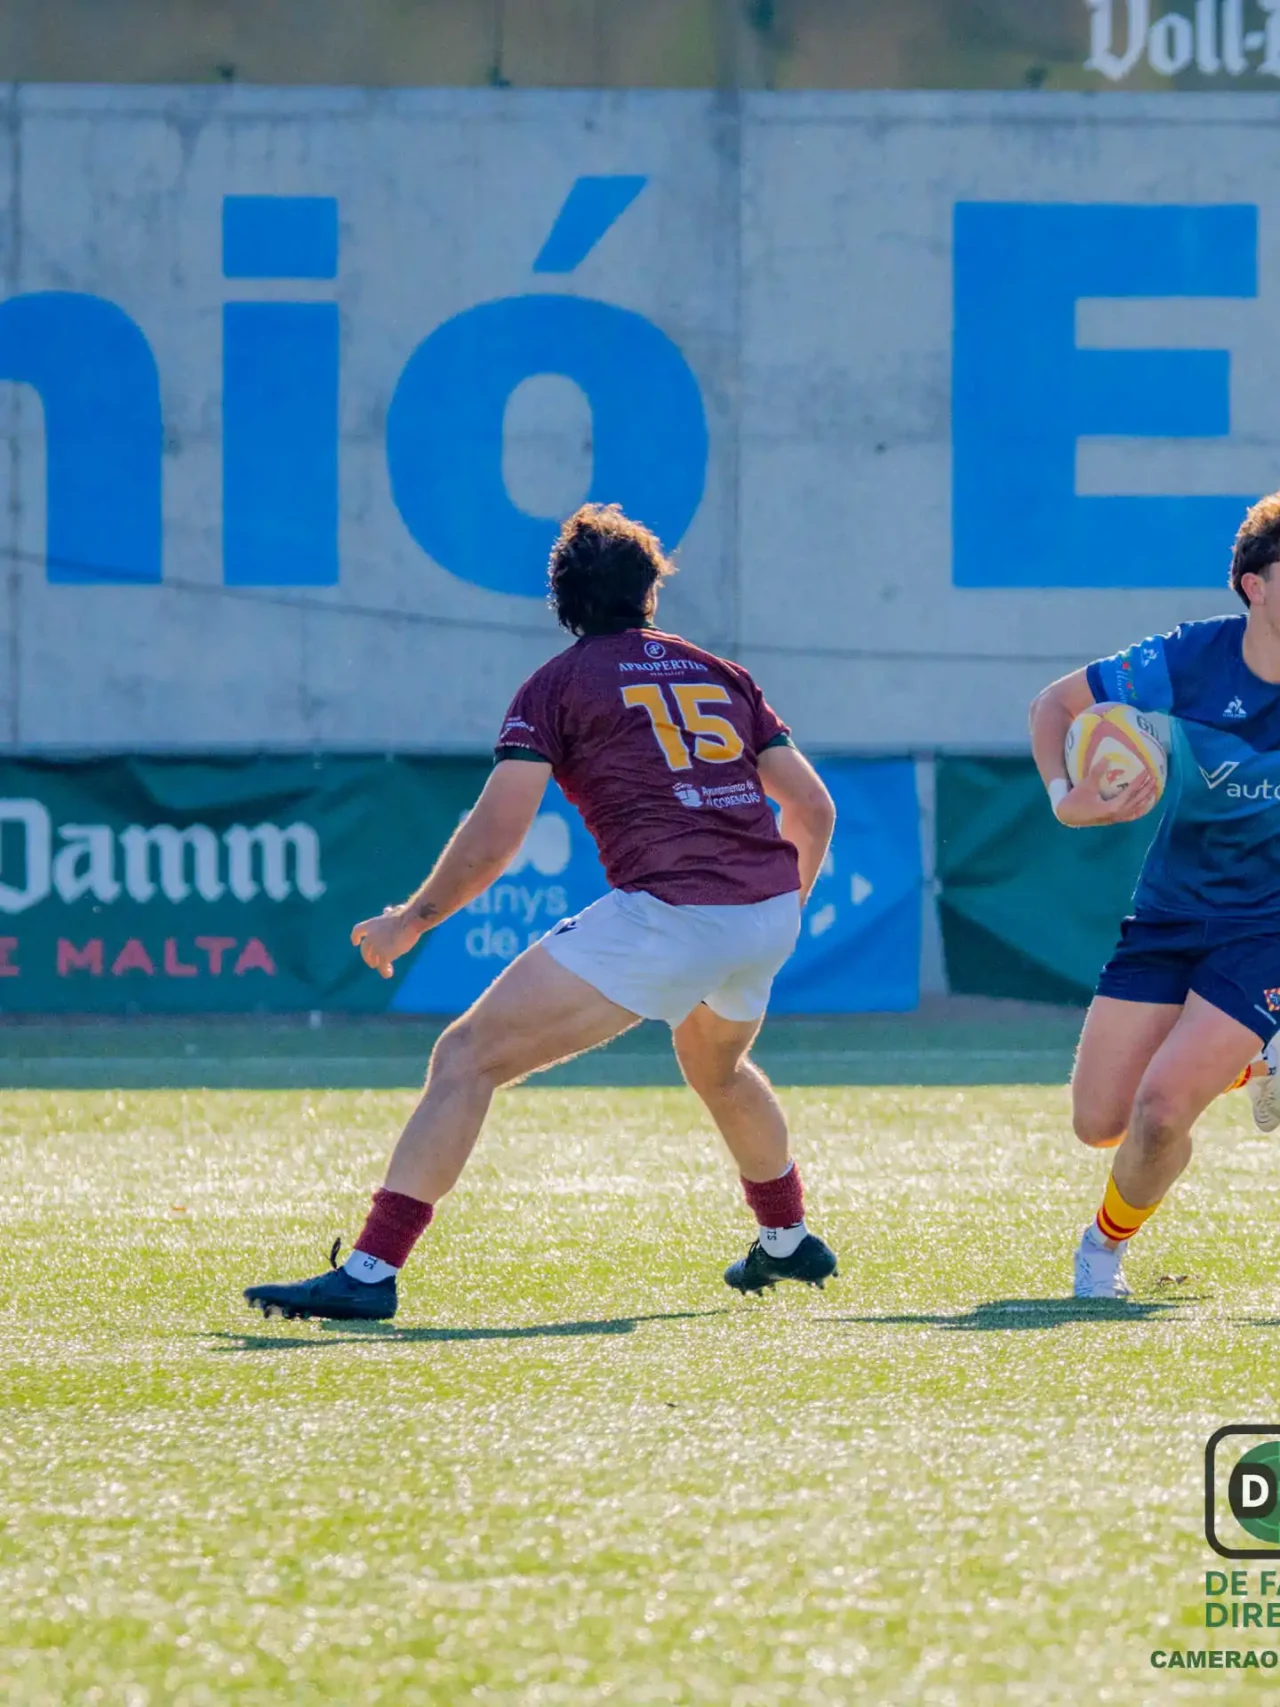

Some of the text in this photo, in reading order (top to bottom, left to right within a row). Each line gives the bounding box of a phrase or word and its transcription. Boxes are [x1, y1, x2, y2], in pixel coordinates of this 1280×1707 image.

[620, 683, 745, 772] 15
[57, 936, 277, 977] MALTA
[465, 921, 519, 960] de
